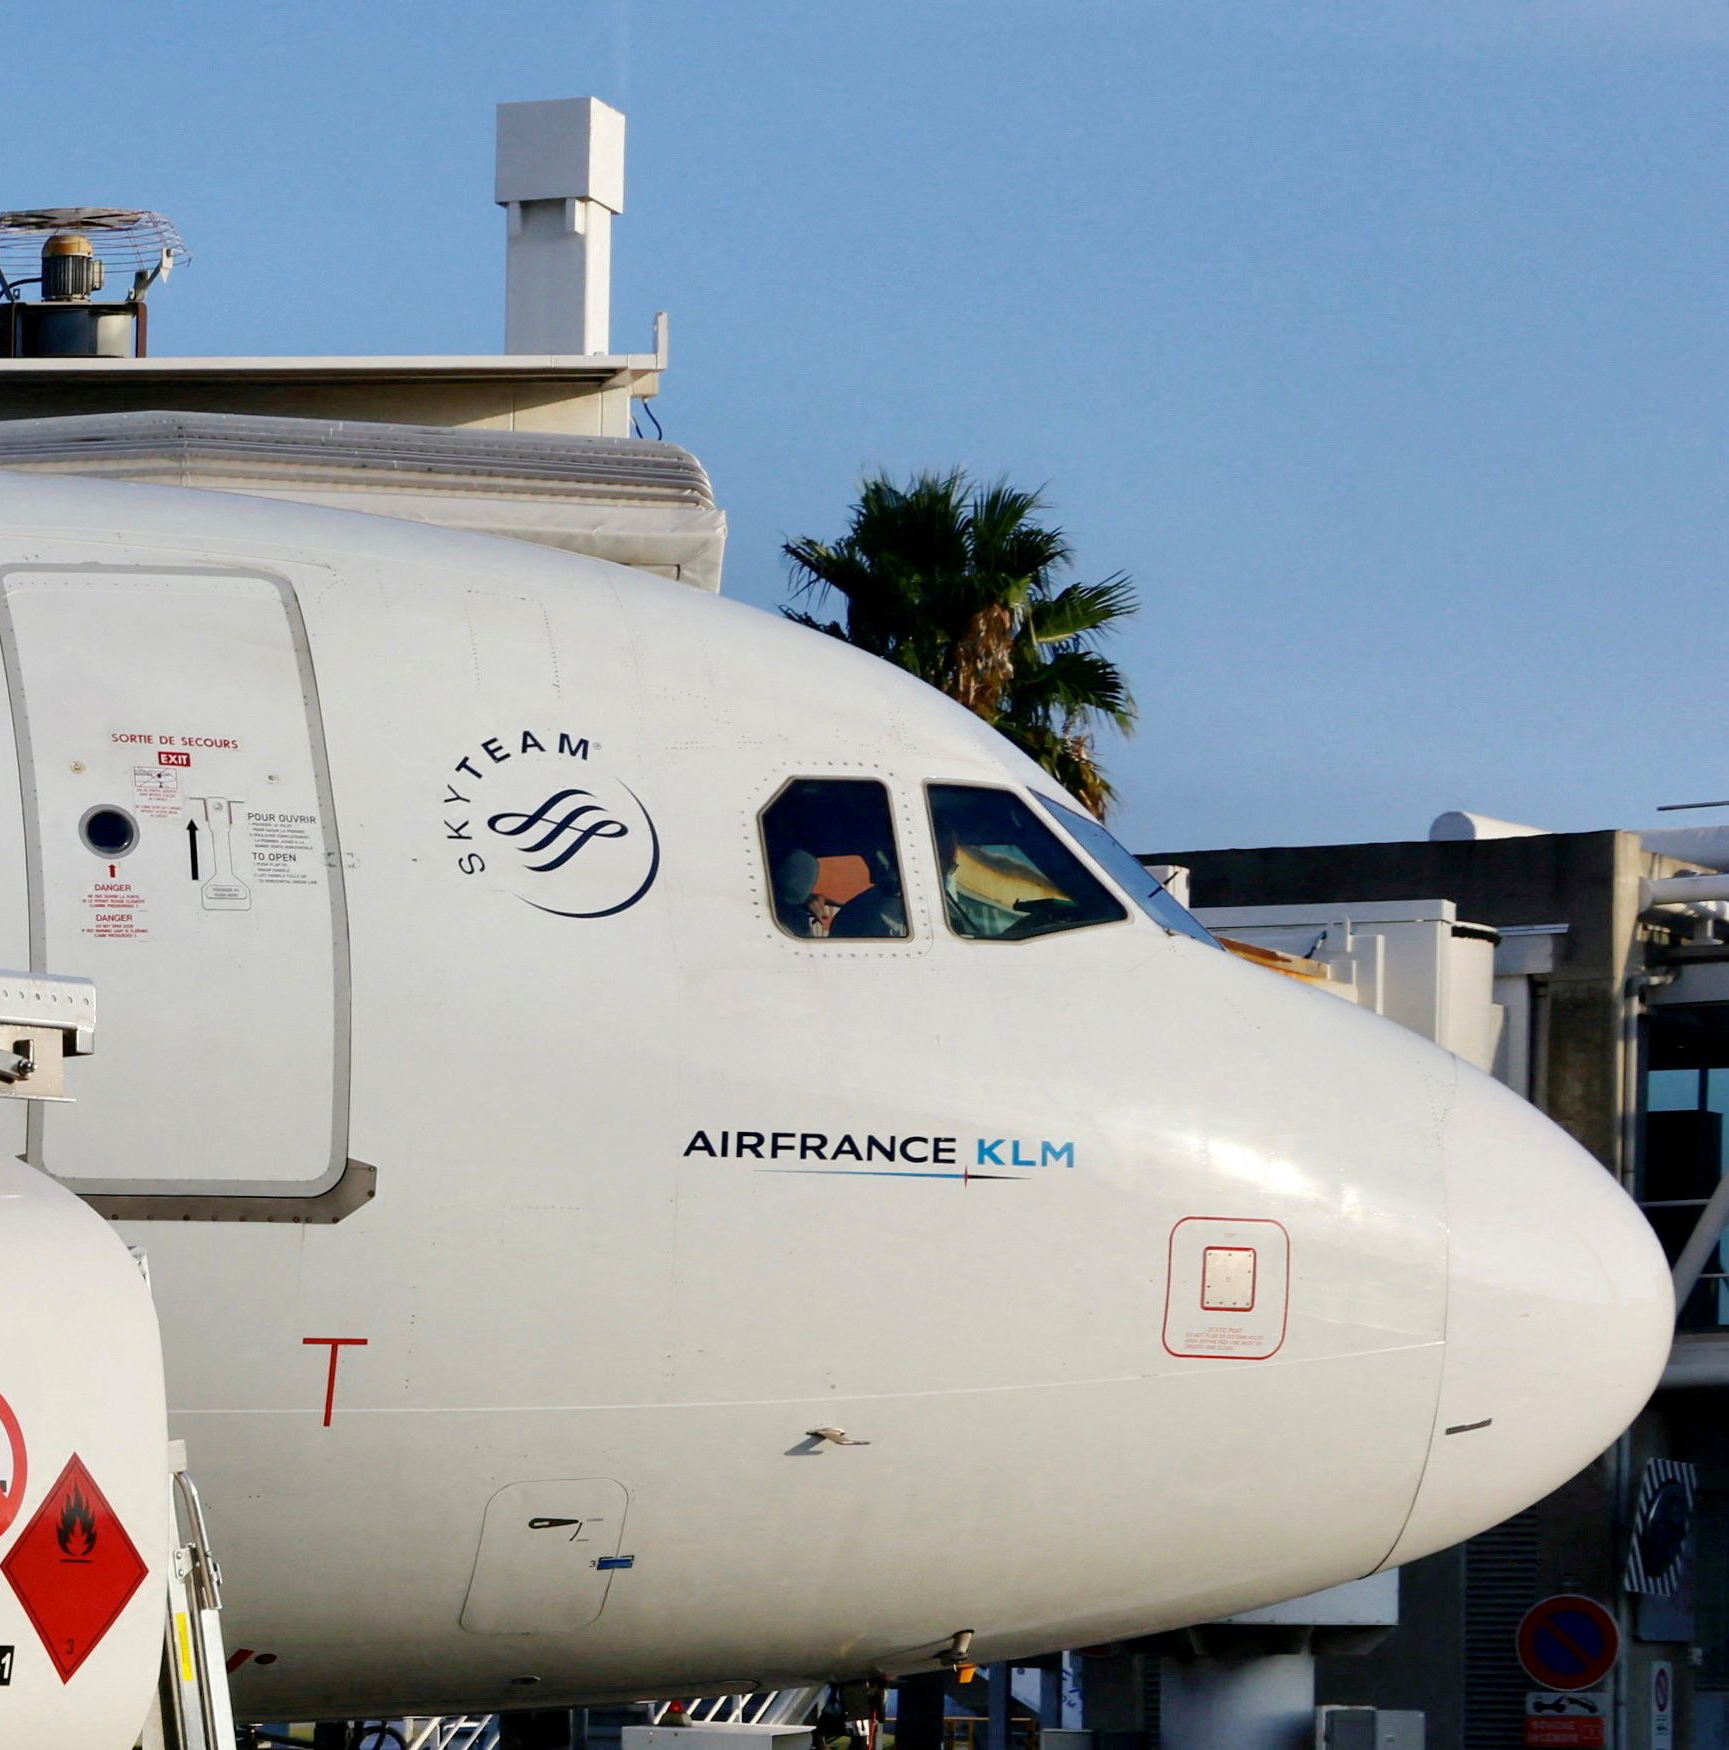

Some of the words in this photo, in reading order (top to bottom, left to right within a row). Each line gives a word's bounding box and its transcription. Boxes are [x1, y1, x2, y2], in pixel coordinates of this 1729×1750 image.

[111, 733, 154, 745] SORTIE
[158, 735, 175, 746] DE
[181, 736, 239, 750] SECOURS
[160, 754, 188, 765] EXIT
[443, 730, 590, 875] SKYTEAM
[247, 812, 276, 823] POUR
[278, 814, 317, 825] OUVRIR
[252, 852, 265, 861] TO
[269, 853, 297, 862] OPEN
[94, 884, 131, 892] DANGER
[96, 914, 133, 922] DANGER
[682, 1130, 957, 1165] AIRFRANCE
[977, 1138, 1075, 1169] KLM
[64, 1639, 76, 1656] 3
